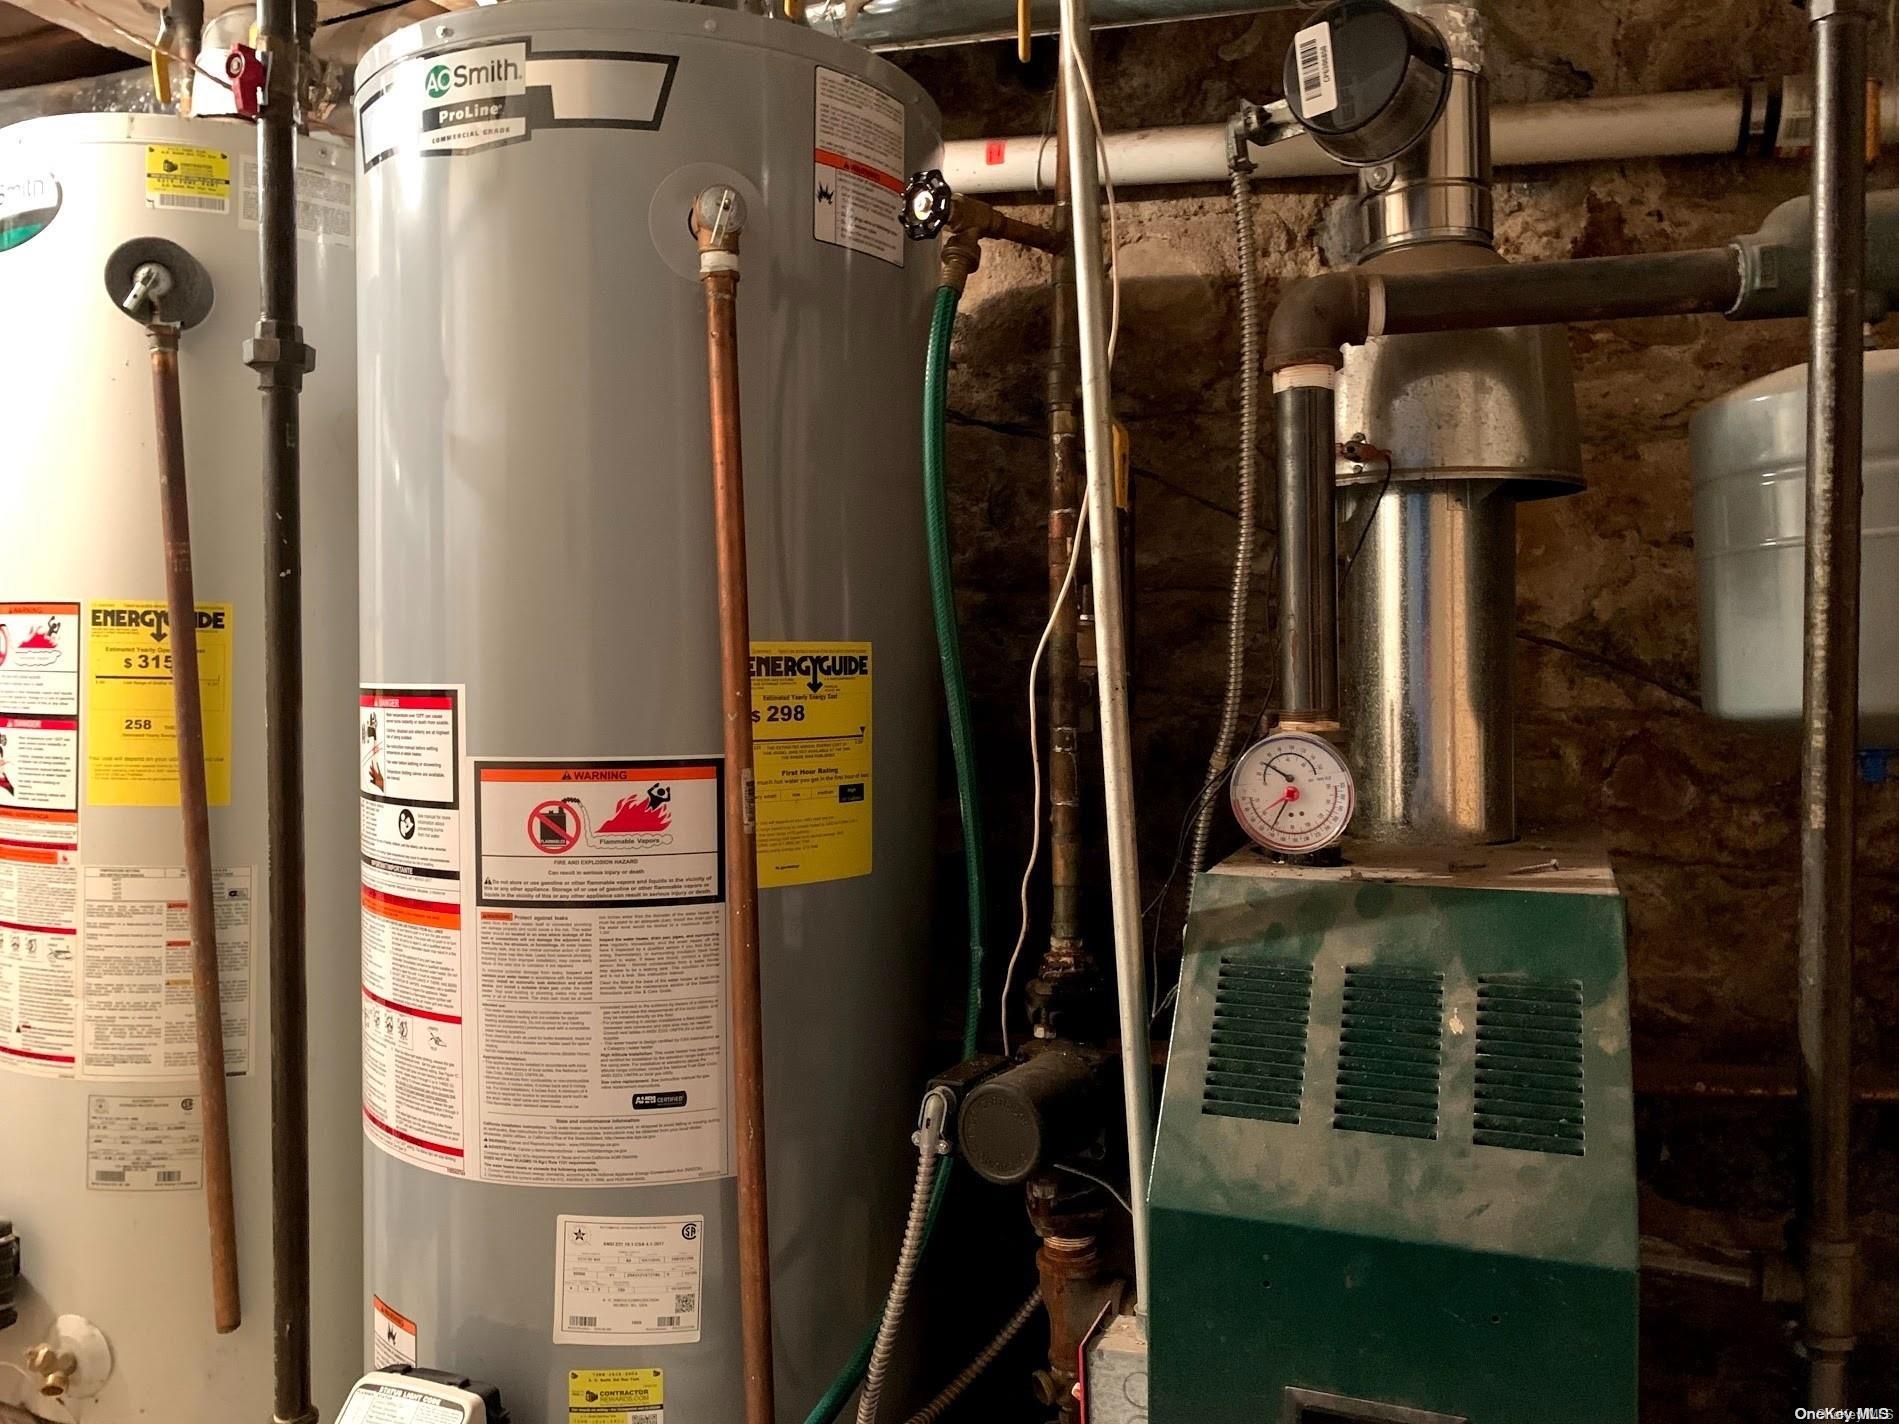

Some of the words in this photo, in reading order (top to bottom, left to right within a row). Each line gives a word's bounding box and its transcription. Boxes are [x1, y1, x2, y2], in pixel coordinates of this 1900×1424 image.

[454, 60, 518, 88] Smith
[439, 104, 500, 124] ProLine
[432, 131, 480, 144] COMMERCIAL
[482, 127, 510, 136] GRADE
[91, 610, 224, 629] ENERGYIDE
[124, 658, 132, 668] $
[748, 656, 868, 677] ENERGYGUIDE
[752, 710, 760, 722] $
[766, 704, 805, 722] 298
[124, 720, 152, 730] 258
[574, 771, 628, 780] WARNING
[379, 1386, 403, 1397] STATUS
[403, 1392, 423, 1402] LIGHT
[423, 1395, 441, 1406] CODE
